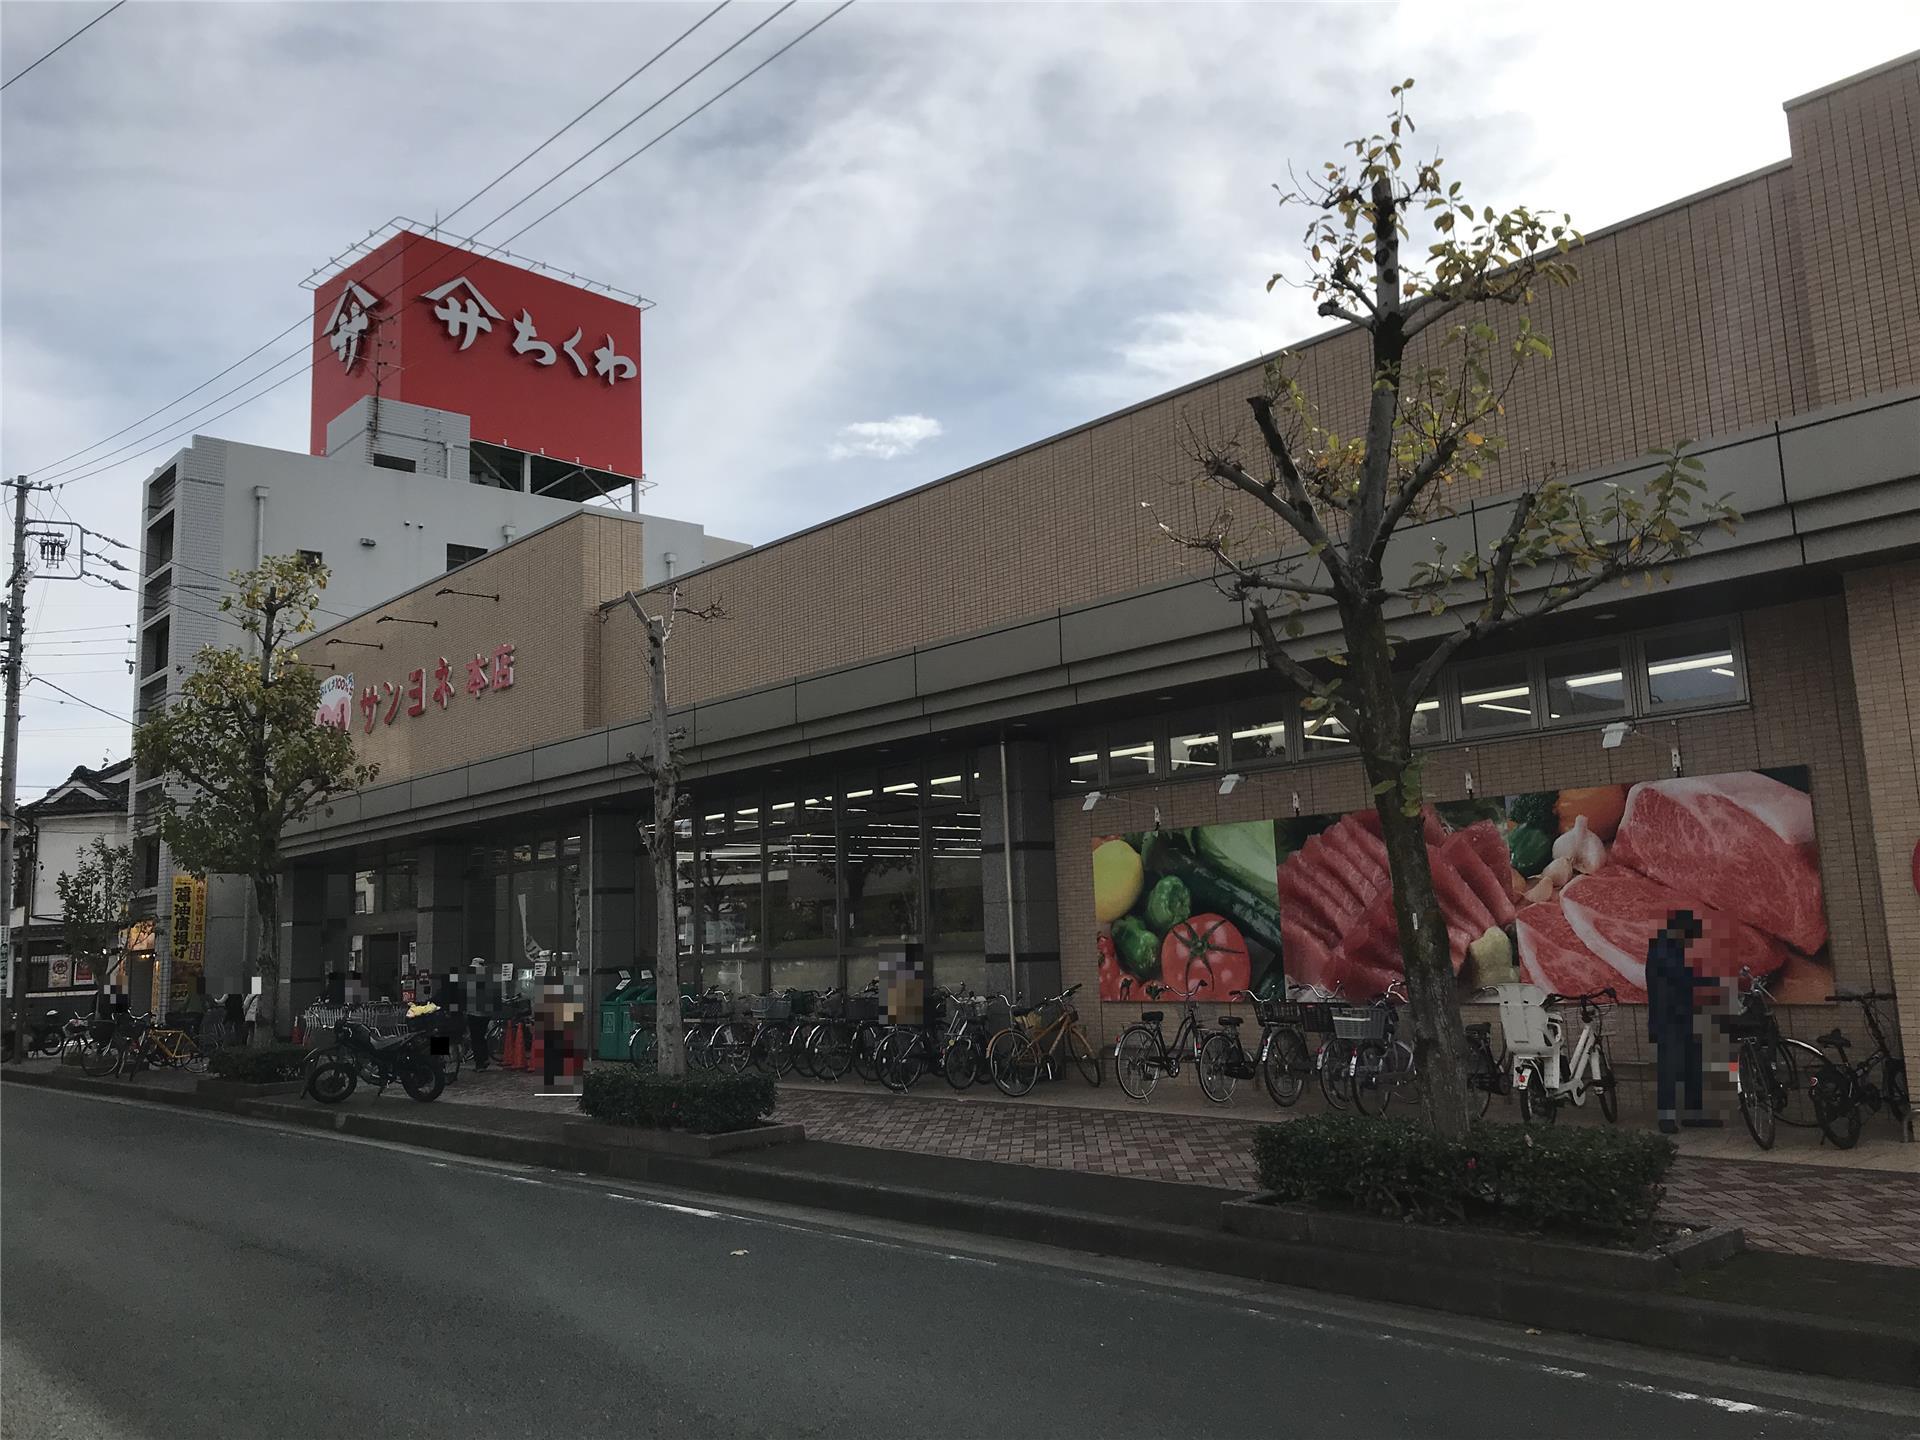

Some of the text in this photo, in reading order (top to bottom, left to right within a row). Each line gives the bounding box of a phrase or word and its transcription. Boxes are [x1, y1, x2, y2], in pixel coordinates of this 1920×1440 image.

[513, 308, 638, 386] ちくわ
[360, 643, 515, 734] サンヨネ 本店
